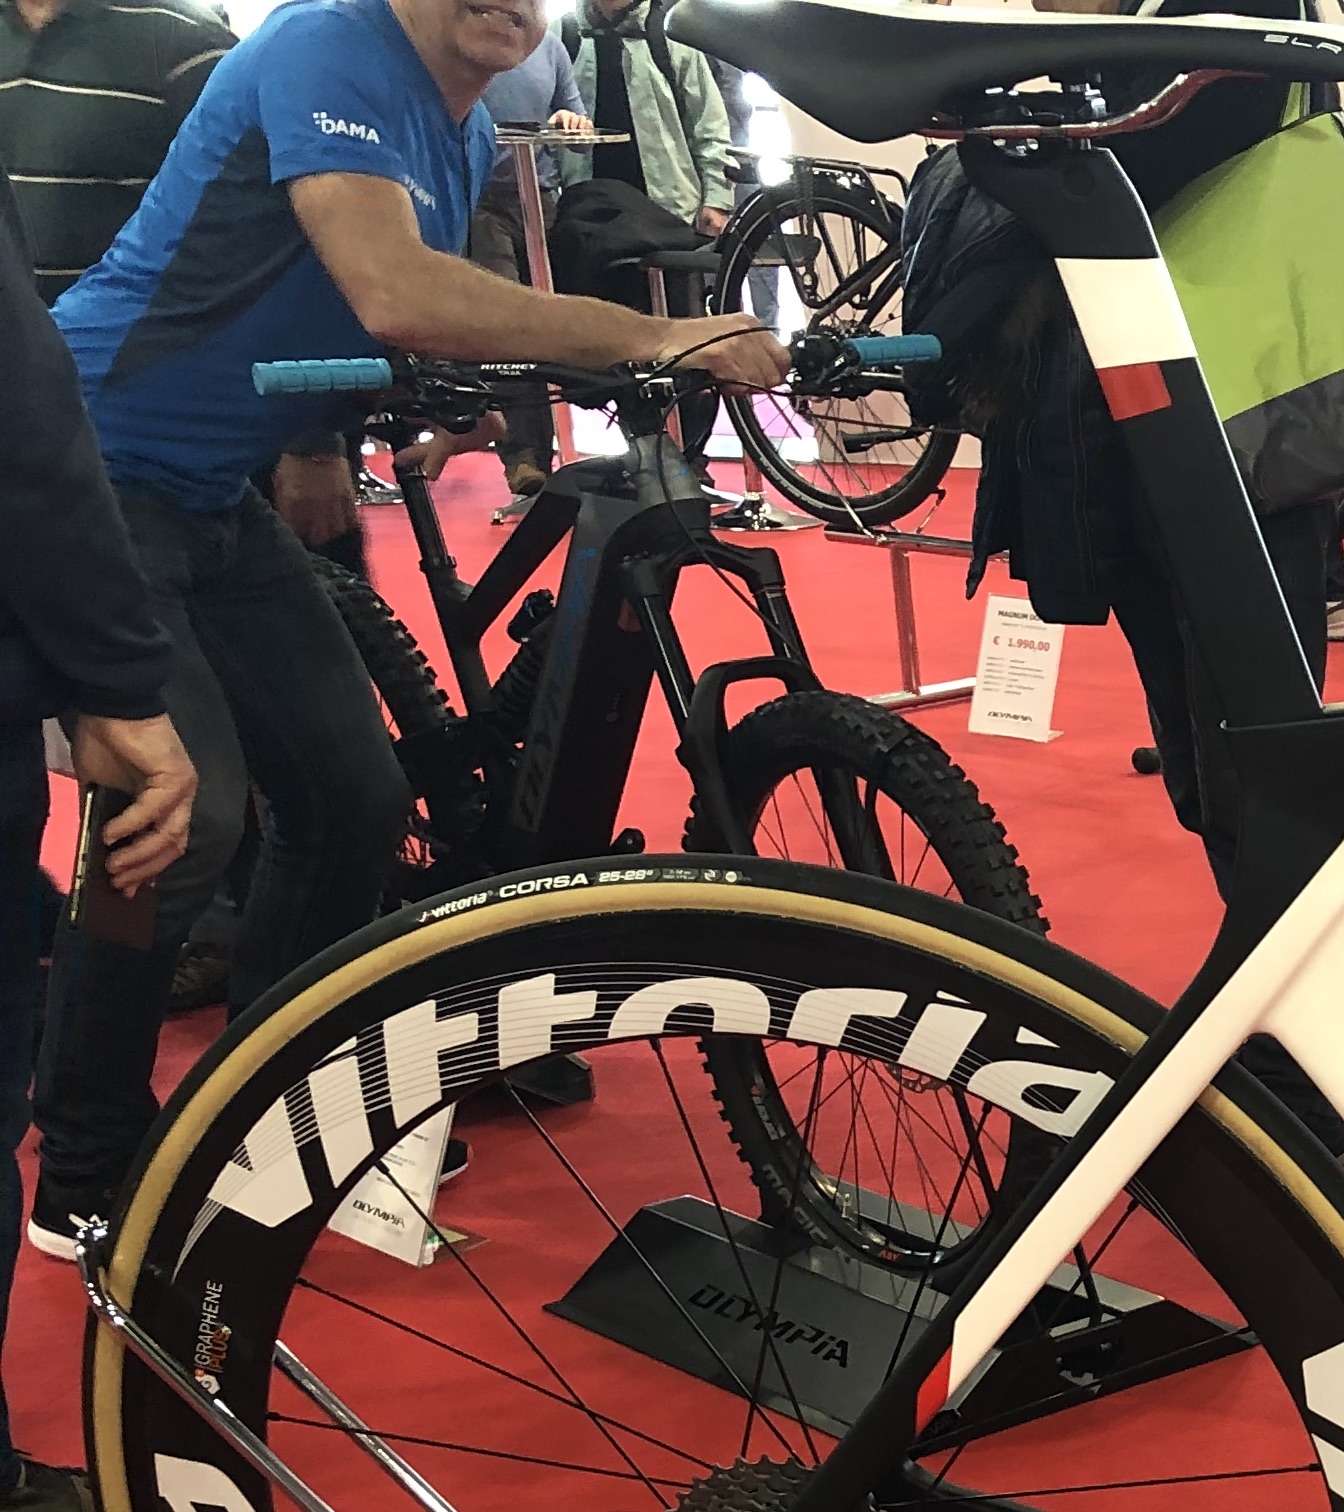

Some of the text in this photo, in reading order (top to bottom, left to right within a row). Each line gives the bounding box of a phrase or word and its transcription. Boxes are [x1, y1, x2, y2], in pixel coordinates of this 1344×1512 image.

[1263, 33, 1342, 54] SLR
[321, 118, 381, 145] DAMA
[480, 363, 538, 371] RITCHEY
[993, 635, 1051, 652] € 1.990,00
[499, 872, 590, 899] CORSA
[194, 1280, 224, 1367] GRAPHENE
